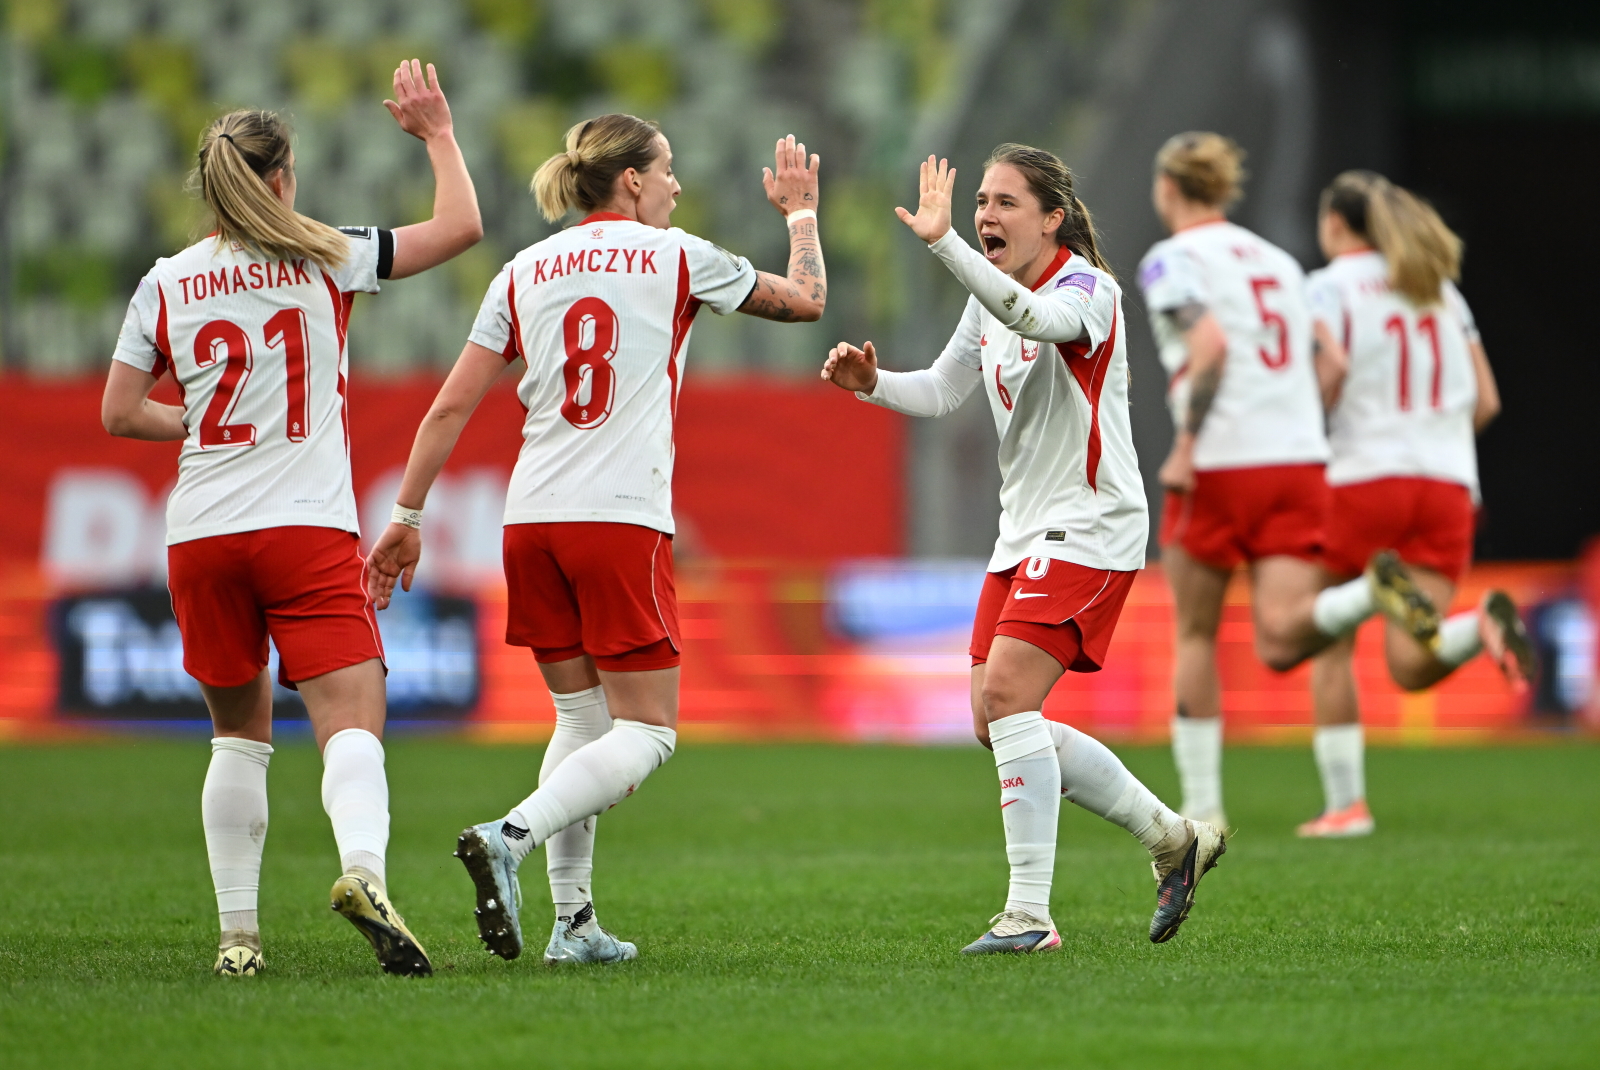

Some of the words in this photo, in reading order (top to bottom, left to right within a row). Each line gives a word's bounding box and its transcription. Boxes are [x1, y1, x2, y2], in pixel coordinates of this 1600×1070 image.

[178, 258, 312, 305] TOMASIAK
[533, 249, 658, 285] KAMCZYK
[560, 296, 619, 430] 8
[1249, 276, 1292, 372] 5
[1384, 312, 1443, 412] 11
[193, 307, 311, 450] 21
[995, 364, 1013, 413] 6
